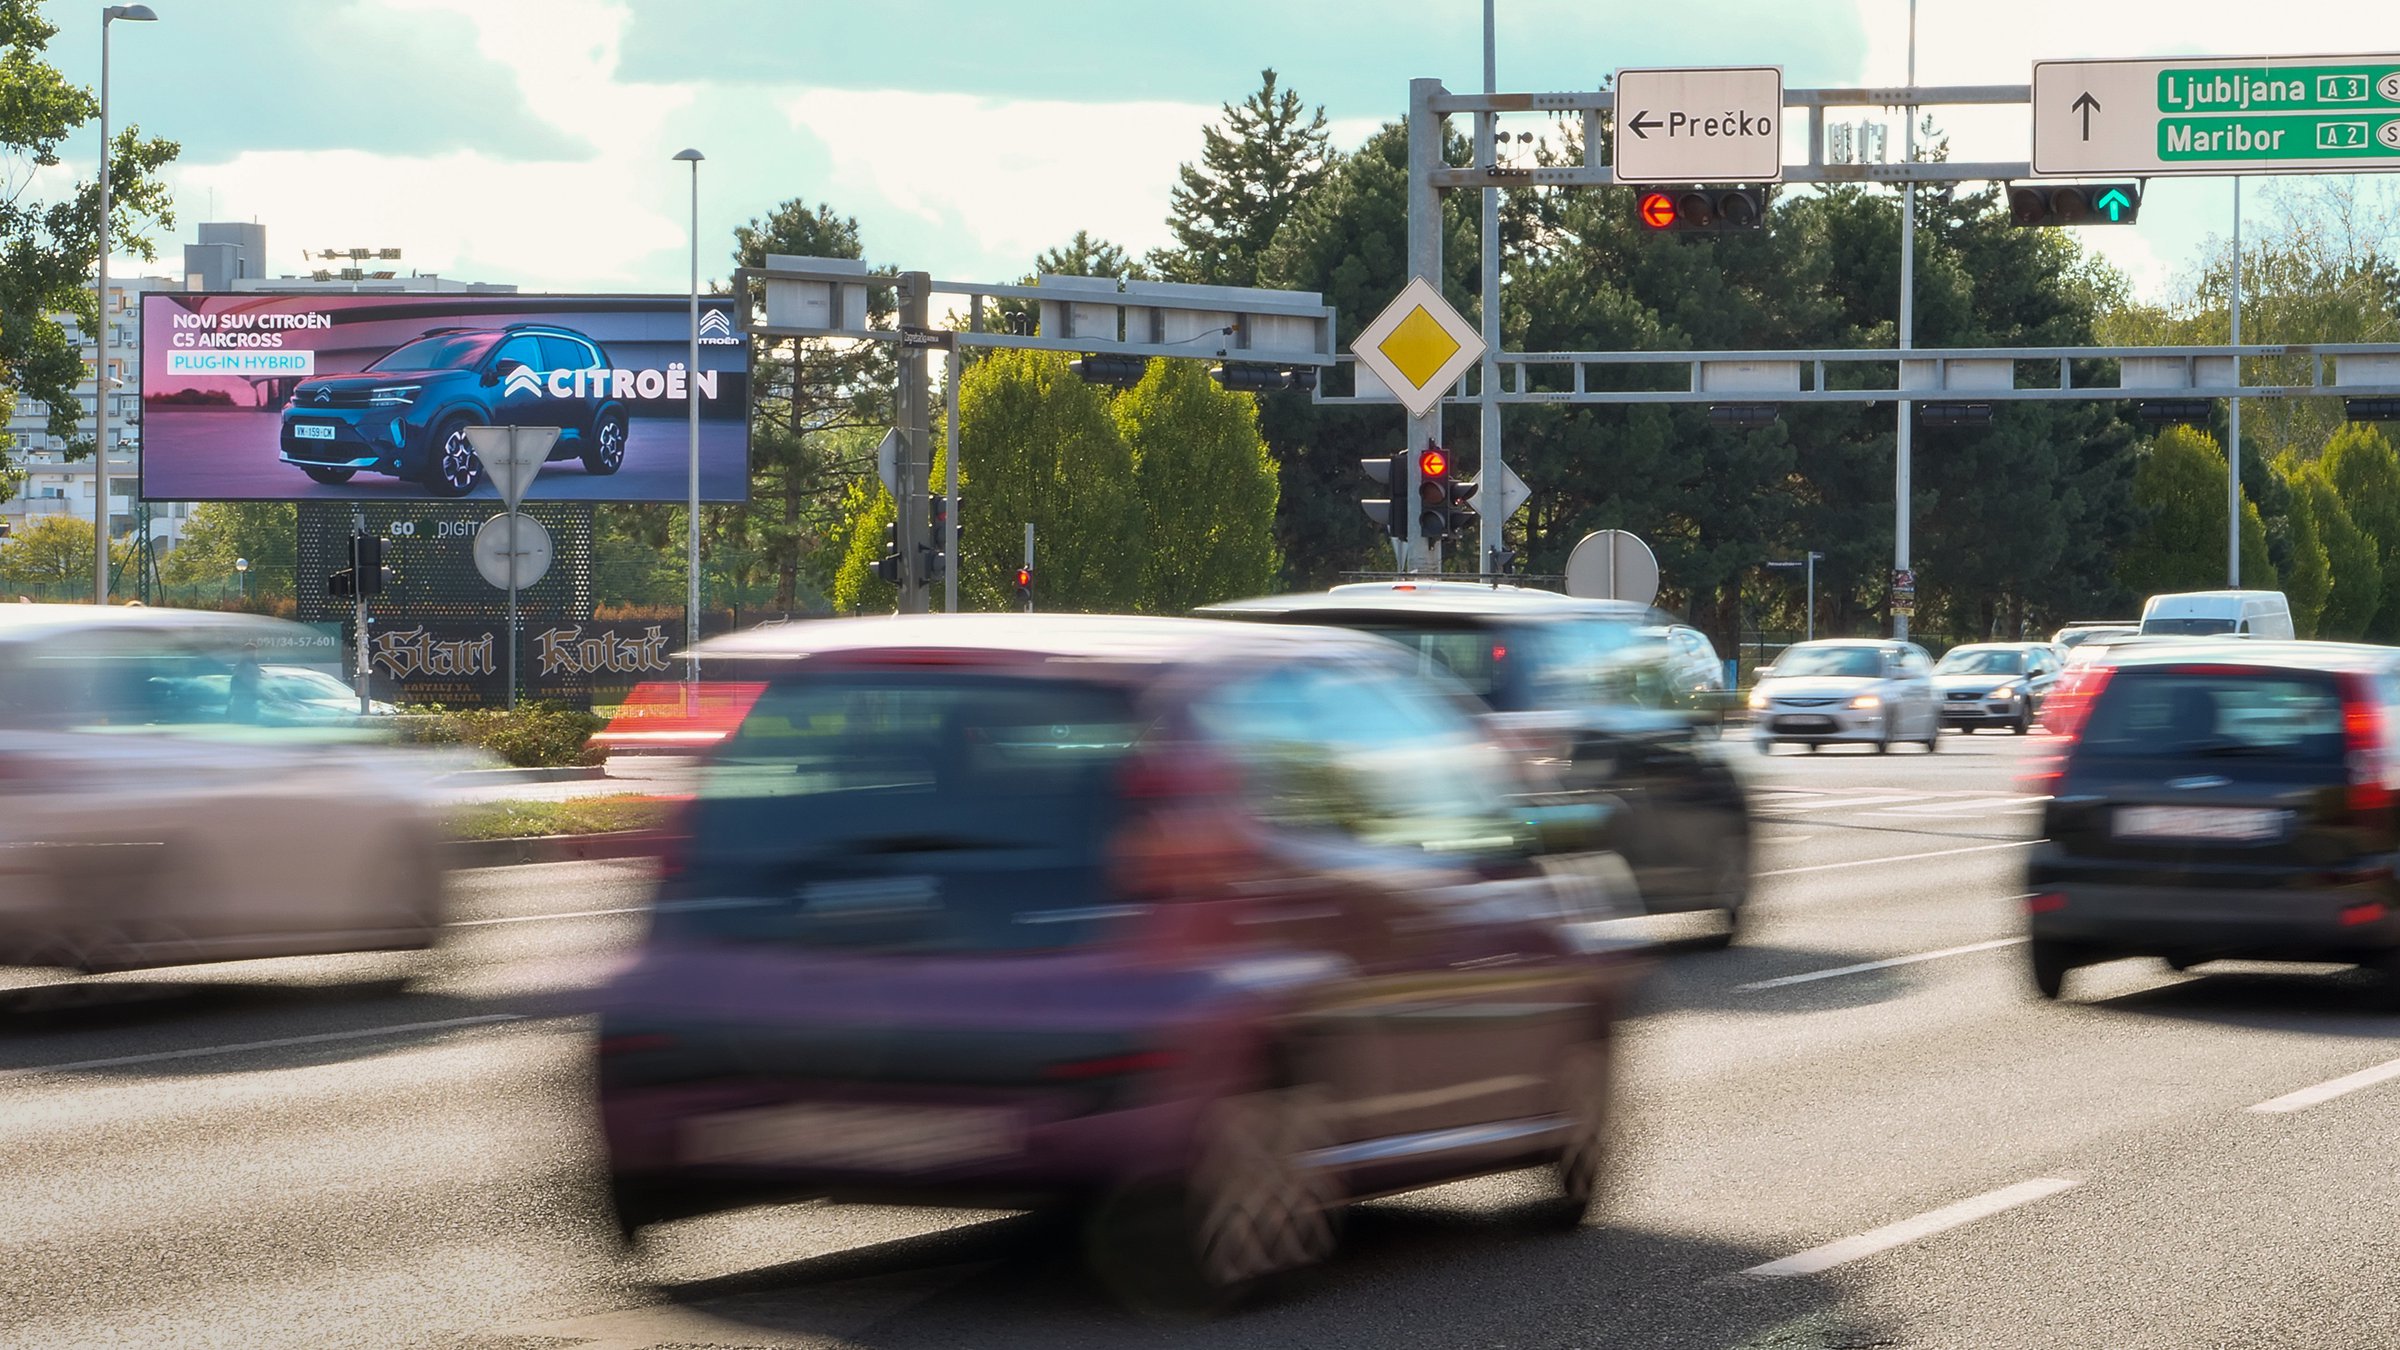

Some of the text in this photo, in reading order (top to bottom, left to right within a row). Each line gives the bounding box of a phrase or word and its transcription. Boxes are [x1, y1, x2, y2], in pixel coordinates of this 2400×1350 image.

[2167, 75, 2305, 110] Ljubljana
[2327, 80, 2338, 97] A
[2348, 80, 2358, 97] 3
[1669, 110, 1772, 137] Prečko
[2167, 124, 2285, 152] Maribor
[2327, 128, 2338, 145] A
[2347, 128, 2358, 144] 2
[173, 312, 331, 329] NOVI SUV CITROËN
[173, 333, 283, 348] C5 AIRCROSS
[698, 336, 740, 346] ITROËN
[175, 355, 306, 369] PLUG-IN HYBRID
[548, 362, 718, 400] CITROËN
[391, 521, 415, 535] GO
[372, 624, 672, 680] Stari Kotač
